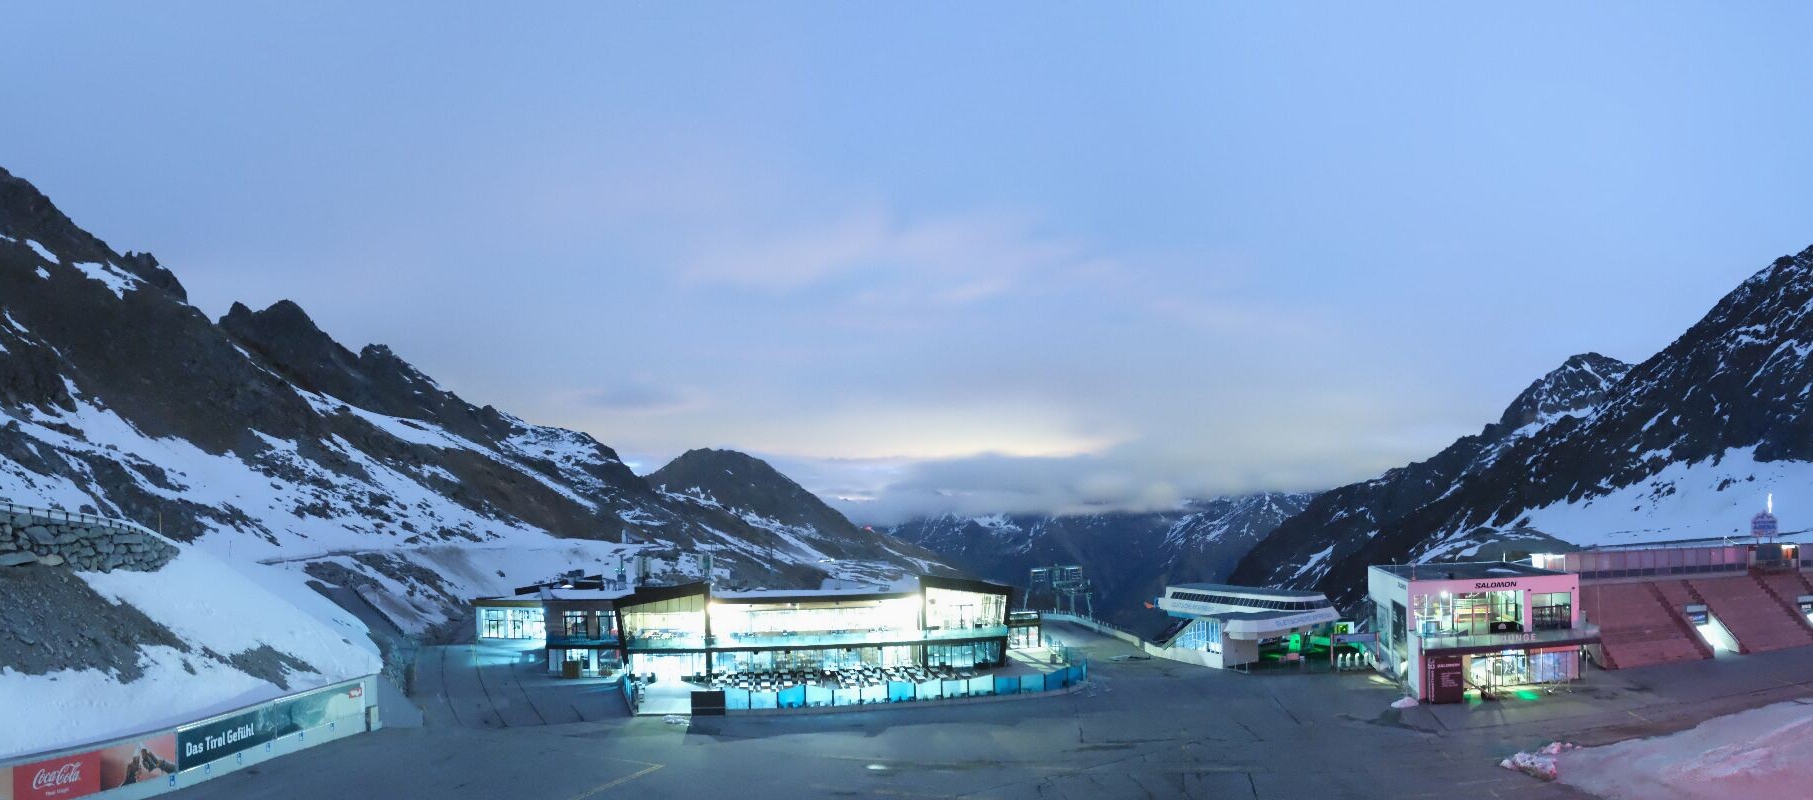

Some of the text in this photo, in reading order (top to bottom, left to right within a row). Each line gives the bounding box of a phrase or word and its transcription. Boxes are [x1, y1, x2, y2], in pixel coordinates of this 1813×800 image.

[1474, 581, 1517, 589] SALOMON
[185, 723, 255, 757] Das Tirol Gefühl
[32, 762, 83, 790] Coca-Cola
